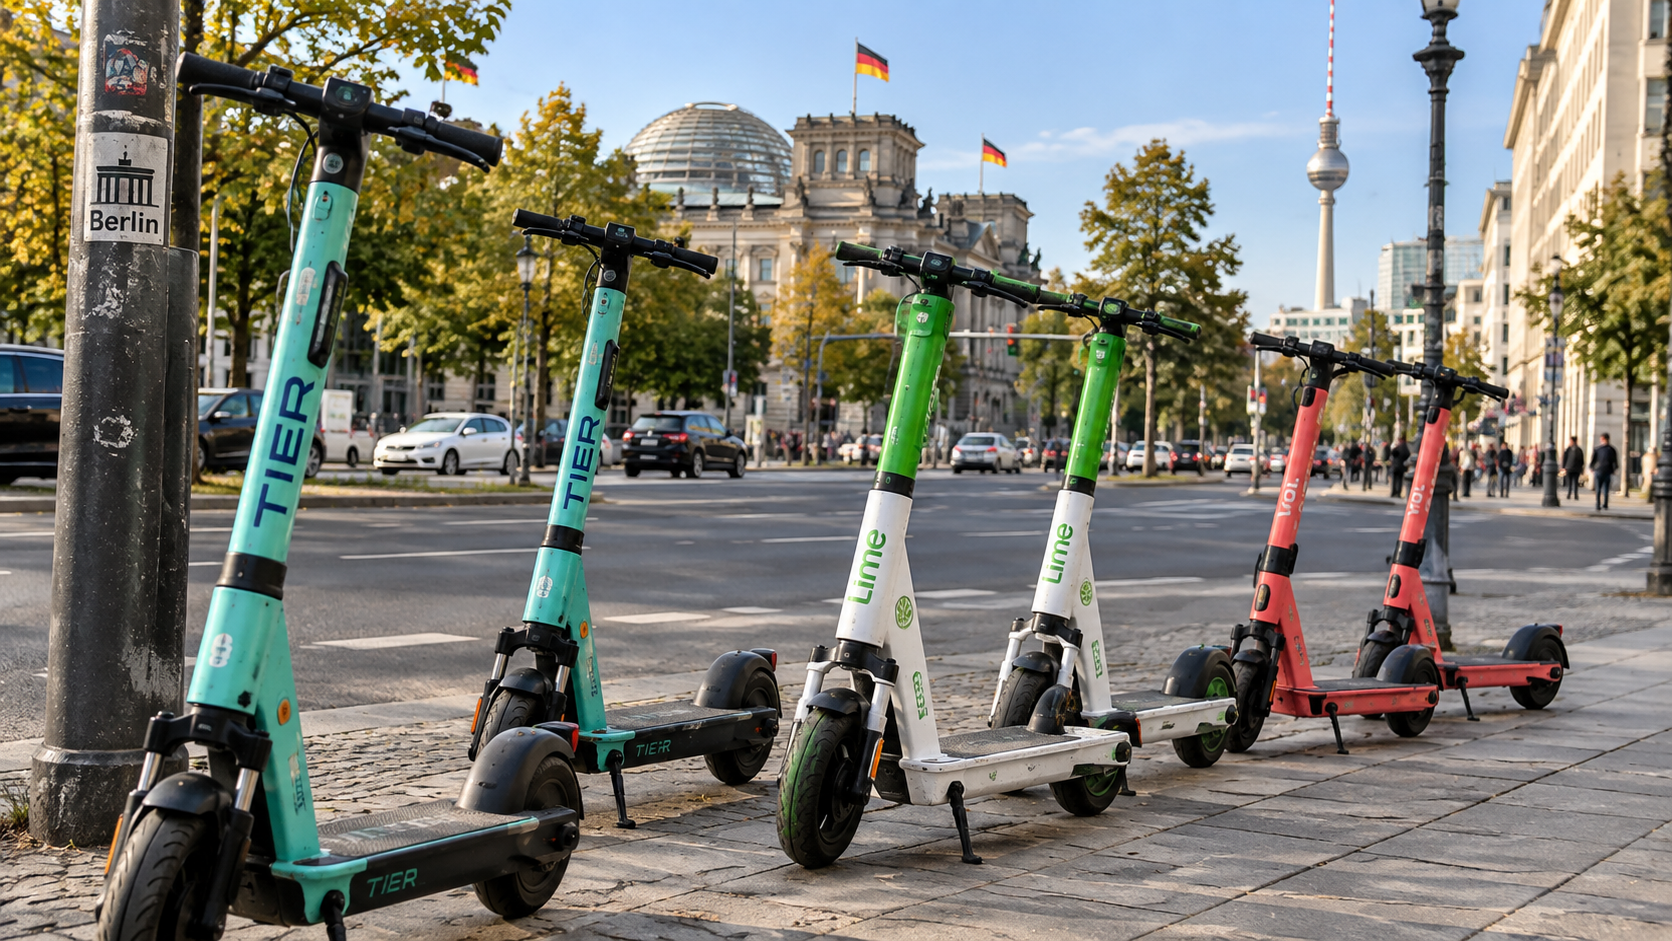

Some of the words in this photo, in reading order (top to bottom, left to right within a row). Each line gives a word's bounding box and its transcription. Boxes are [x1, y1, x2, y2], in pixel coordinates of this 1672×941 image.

[90, 209, 159, 234] Berlin
[253, 376, 315, 527] TIER
[563, 415, 600, 510] TIER
[847, 529, 887, 605] Lime
[1041, 523, 1074, 584] Lime
[366, 867, 418, 898] TIER
